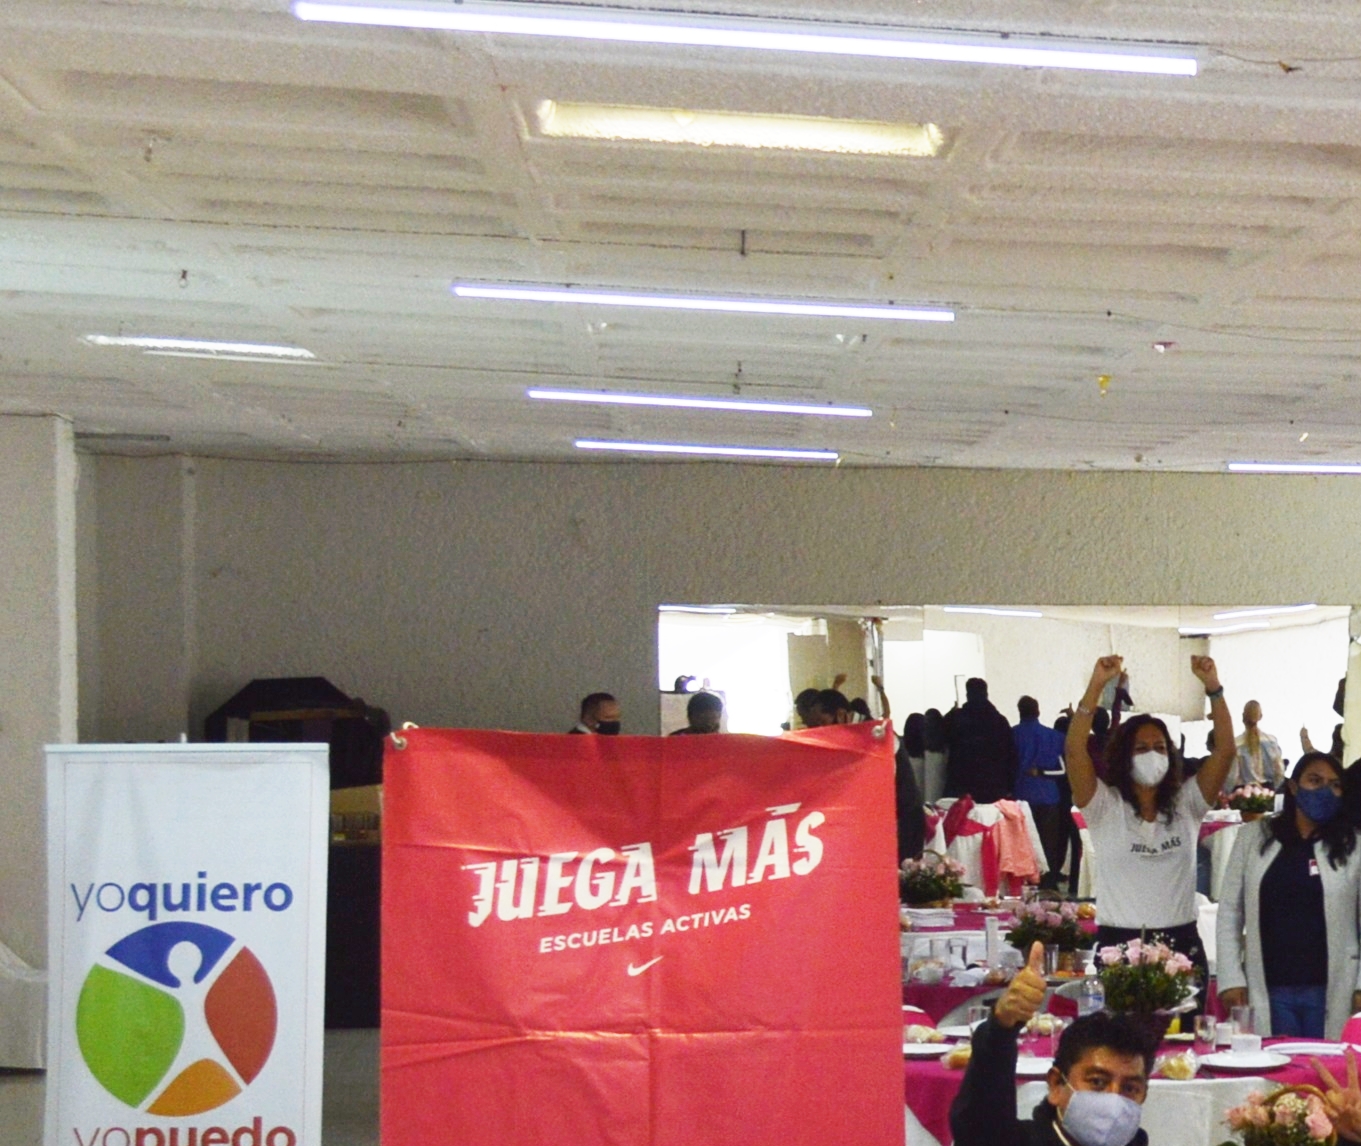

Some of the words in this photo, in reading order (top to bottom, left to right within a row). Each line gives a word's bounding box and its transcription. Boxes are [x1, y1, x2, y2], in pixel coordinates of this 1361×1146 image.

[461, 841, 658, 928] JUEGA
[687, 802, 826, 895] MÁS
[71, 870, 293, 922] yoquiero
[538, 921, 654, 954] ESCUELAS
[659, 903, 752, 936] ACTIVAS
